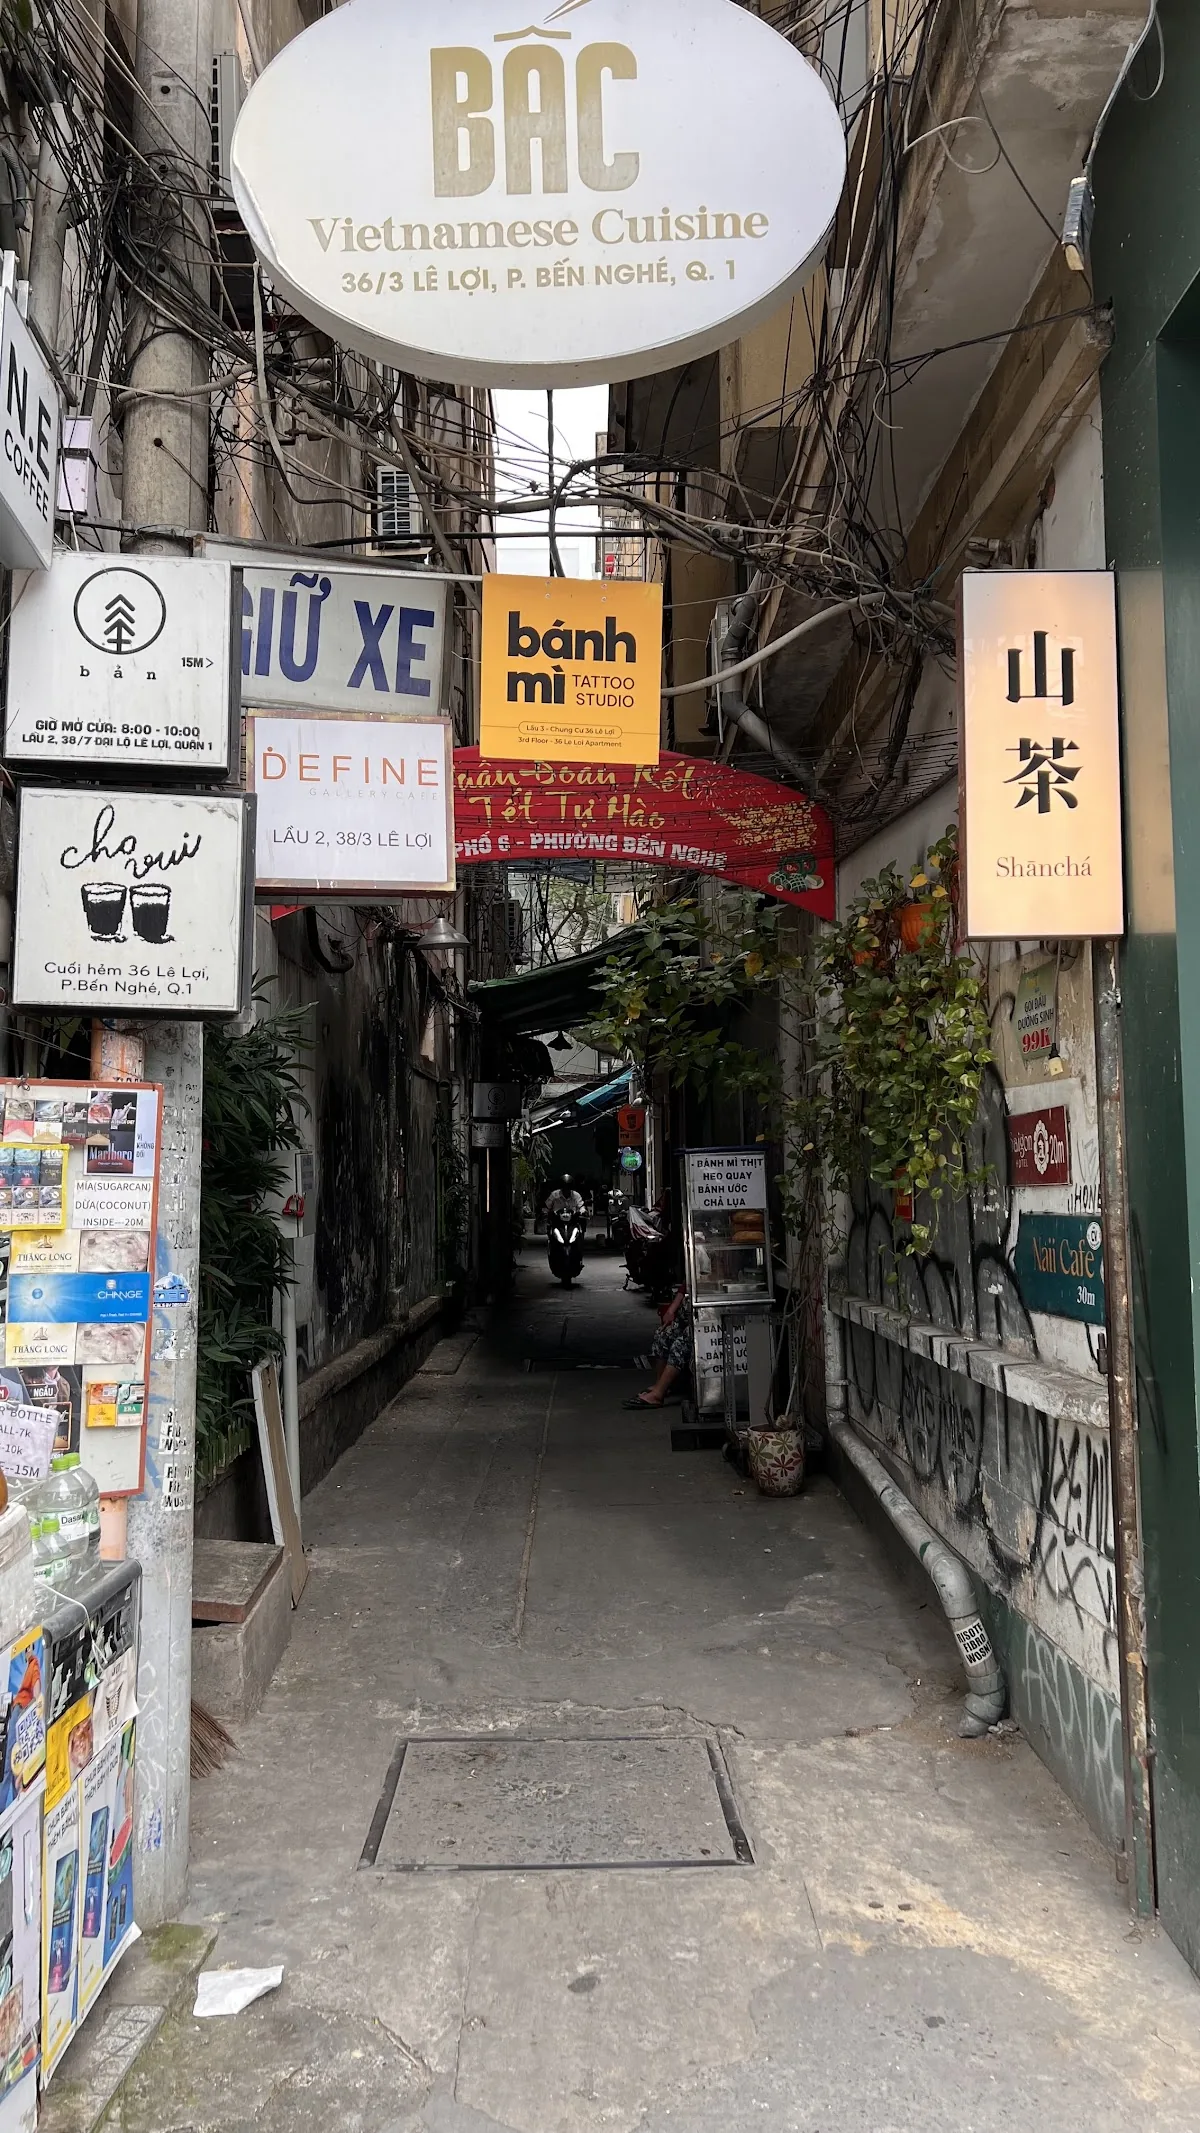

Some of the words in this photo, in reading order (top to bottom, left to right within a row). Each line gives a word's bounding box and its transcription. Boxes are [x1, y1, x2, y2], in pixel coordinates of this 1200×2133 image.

[306, 212, 579, 254] Vietnamese
[591, 204, 770, 246] Cuisine
[341, 271, 405, 295] 36/3
[413, 262, 440, 292] LÊ
[448, 264, 498, 297] LỢI,
[506, 264, 527, 290] P.
[536, 258, 584, 288] BẾN
[595, 257, 676, 288] NGHÉ,
[685, 260, 716, 284] Q.
[725, 260, 736, 281] 1
[4, 428, 49, 522] COFFEE
[506, 610, 638, 664] bánh
[347, 599, 436, 698] XE
[181, 656, 204, 668] 15M
[506, 665, 566, 705] mì
[572, 674, 635, 690] TATTOO
[575, 692, 635, 708] STUDIO
[35, 716, 58, 732] GIỜ
[61, 717, 84, 733] MỞ
[86, 718, 118, 734] CỬA:
[121, 723, 152, 735] 8:00
[163, 725, 201, 737] 10:00
[550, 726, 573, 734] Chung
[1002, 630, 1084, 814] 山茶
[61, 734, 92, 746] 38/7
[134, 736, 149, 748] LÊ
[174, 738, 205, 751] QUẬN
[207, 741, 213, 751] 1
[585, 740, 622, 748] Apartment
[309, 787, 387, 799] GALLERY
[468, 787, 543, 829] Tết
[544, 790, 597, 829] Tự
[607, 793, 666, 830] Hào
[315, 830, 330, 848] 2,
[336, 831, 372, 846] 38/3
[378, 830, 400, 847] LÊ
[405, 832, 432, 850] LỢI
[996, 855, 1092, 878] Shānchá
[44, 961, 82, 974] Cuối
[87, 963, 122, 976] hẻm
[128, 964, 151, 977] 36
[156, 965, 176, 978] Lê
[182, 966, 209, 981] Lợi,
[61, 978, 108, 992] P.Bến
[115, 980, 161, 996] Nghé,
[167, 982, 192, 995] Q.1
[1022, 1027, 1052, 1054] 99K
[89, 1142, 133, 1160] Marlboro
[1049, 1134, 1065, 1165] 20m
[697, 1158, 724, 1168] BÁNH
[727, 1157, 738, 1167] MÌ
[741, 1158, 764, 1169] THỊT
[703, 1172, 723, 1181] HEO
[726, 1171, 752, 1180] QUAY
[698, 1184, 725, 1194] BÁNH
[1059, 1238, 1095, 1279] Cafe
[97, 1290, 143, 1301] CHANGE
[1077, 1285, 1096, 1307] 30m
[10, 1409, 53, 1424] BOTTLE
[123, 1405, 136, 1413] ERA
[963, 1633, 986, 1652] FIBRO
